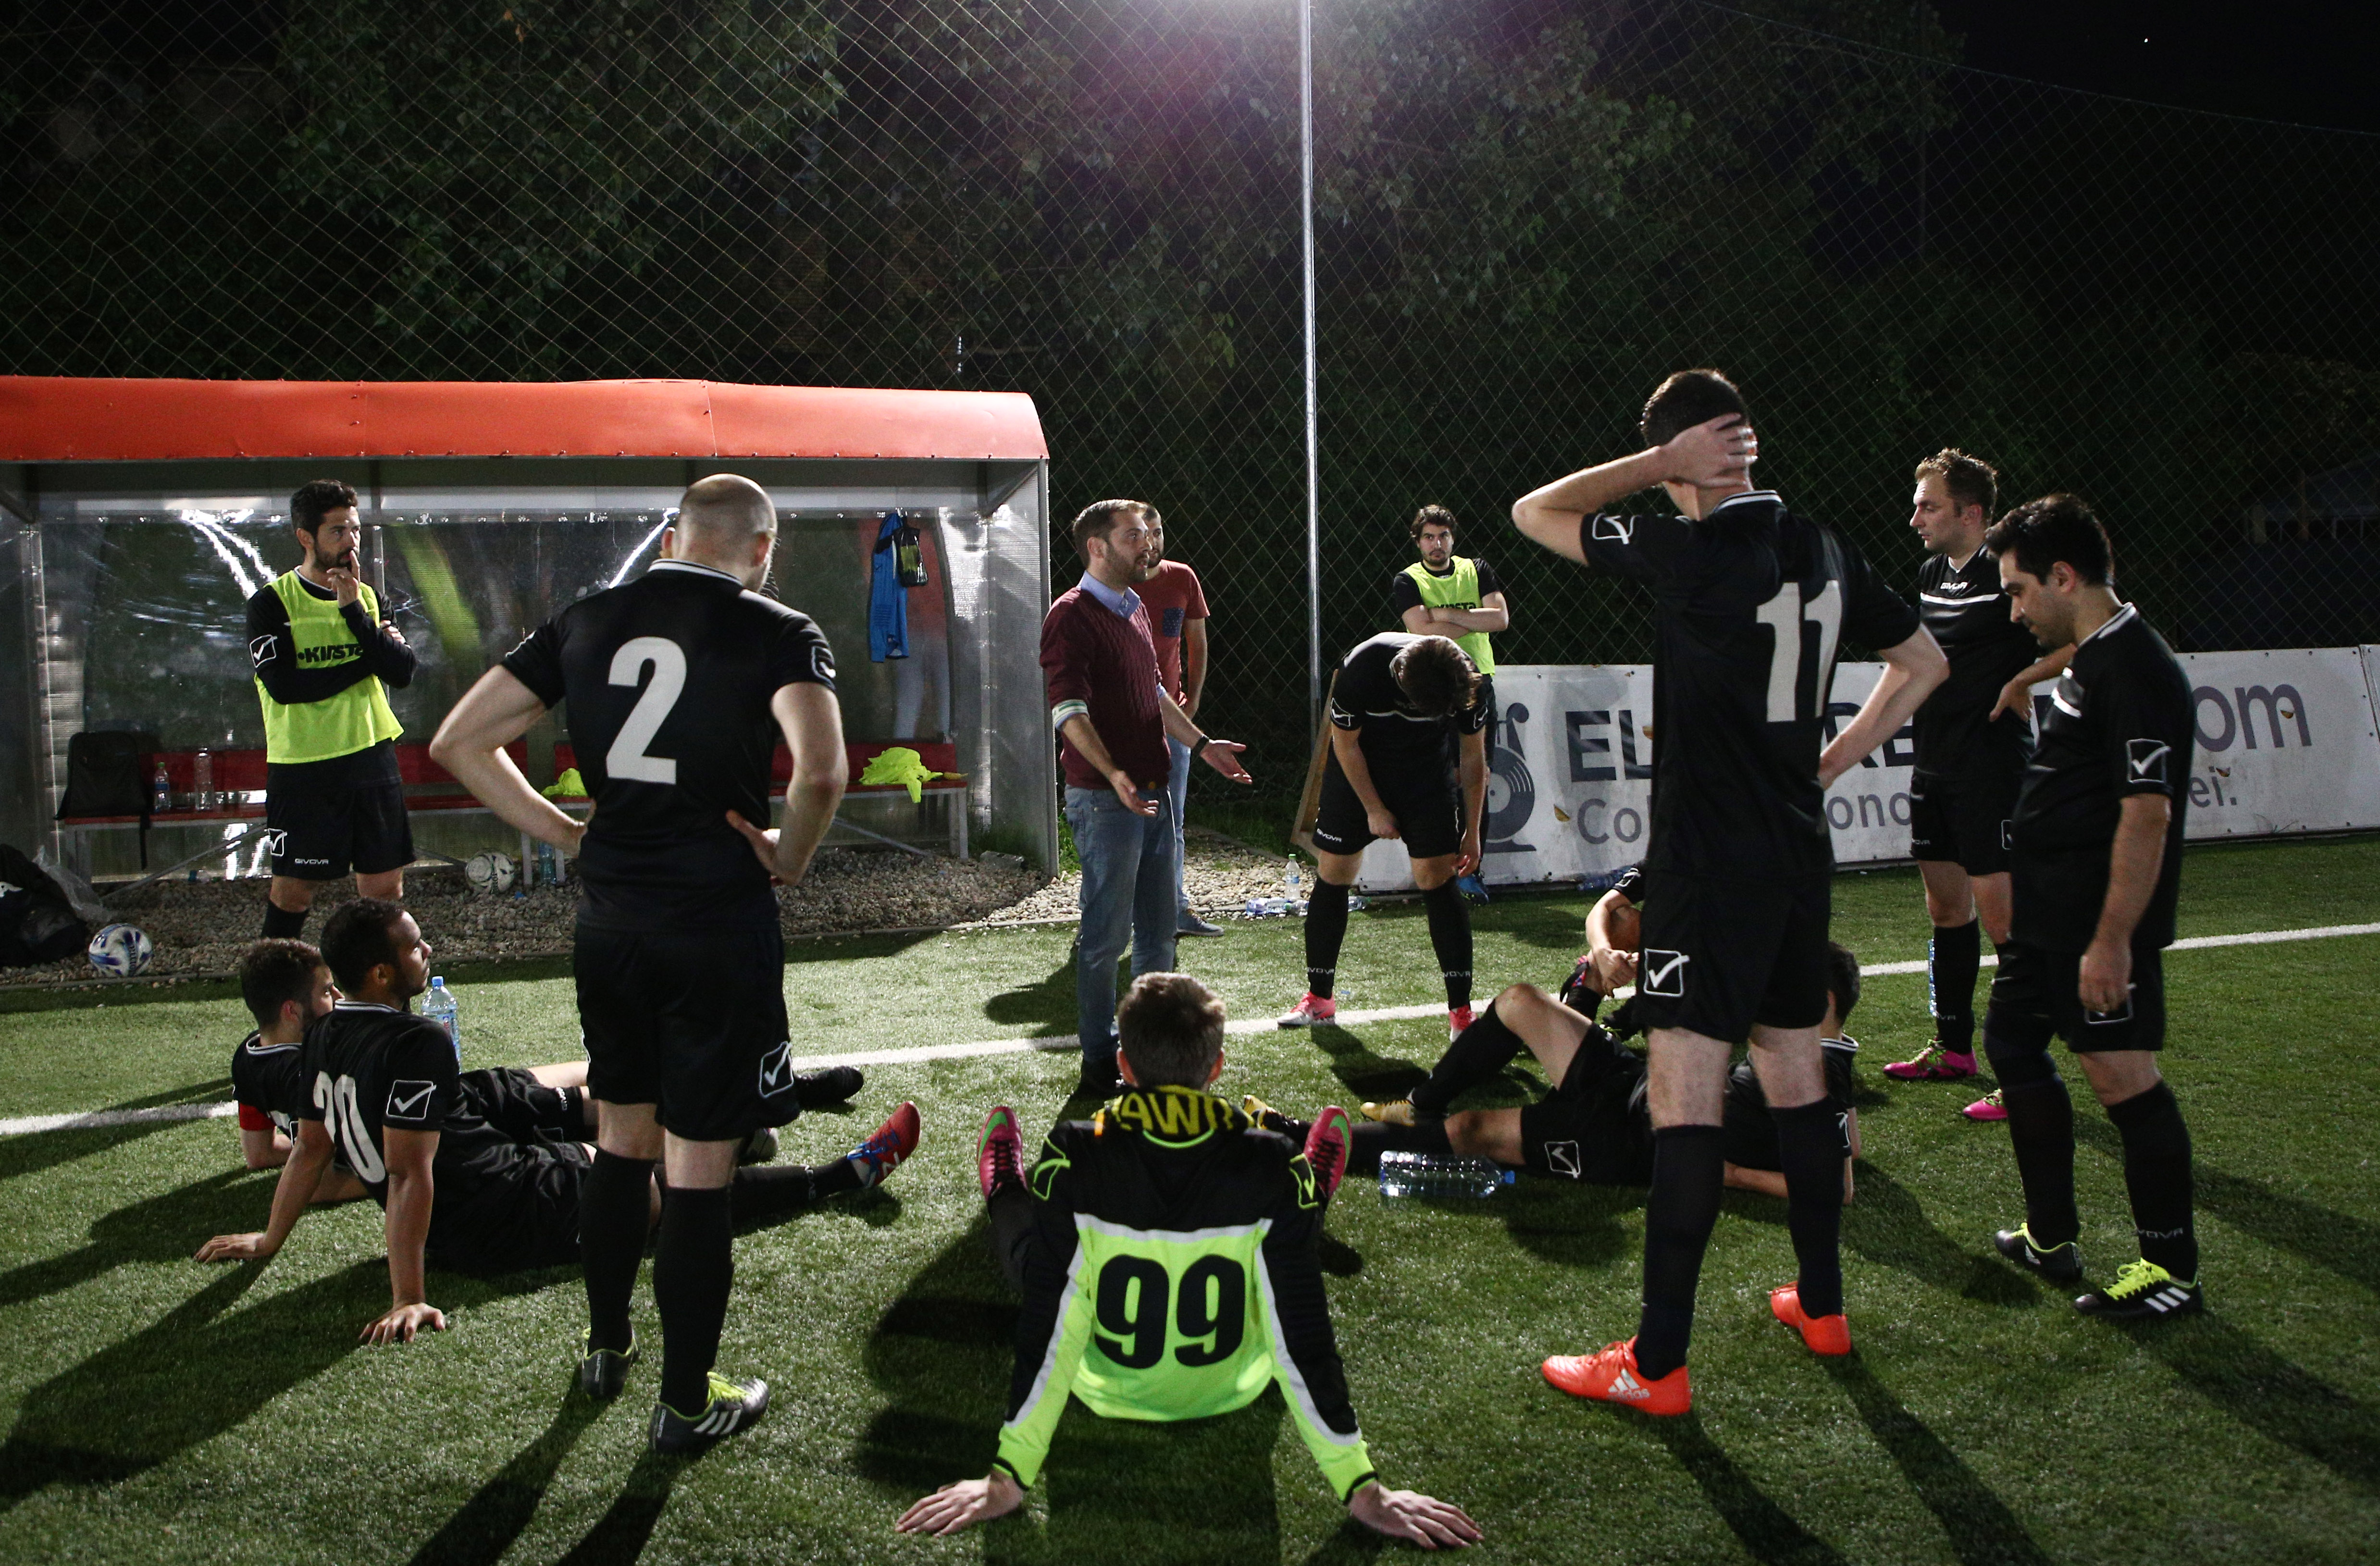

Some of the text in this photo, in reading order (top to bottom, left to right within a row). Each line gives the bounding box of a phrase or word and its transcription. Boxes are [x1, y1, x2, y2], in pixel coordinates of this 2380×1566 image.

[606, 636, 687, 785] 2
[1756, 580, 1843, 722] 11
[313, 1070, 385, 1184] 20
[1094, 1254, 1246, 1369] 99
